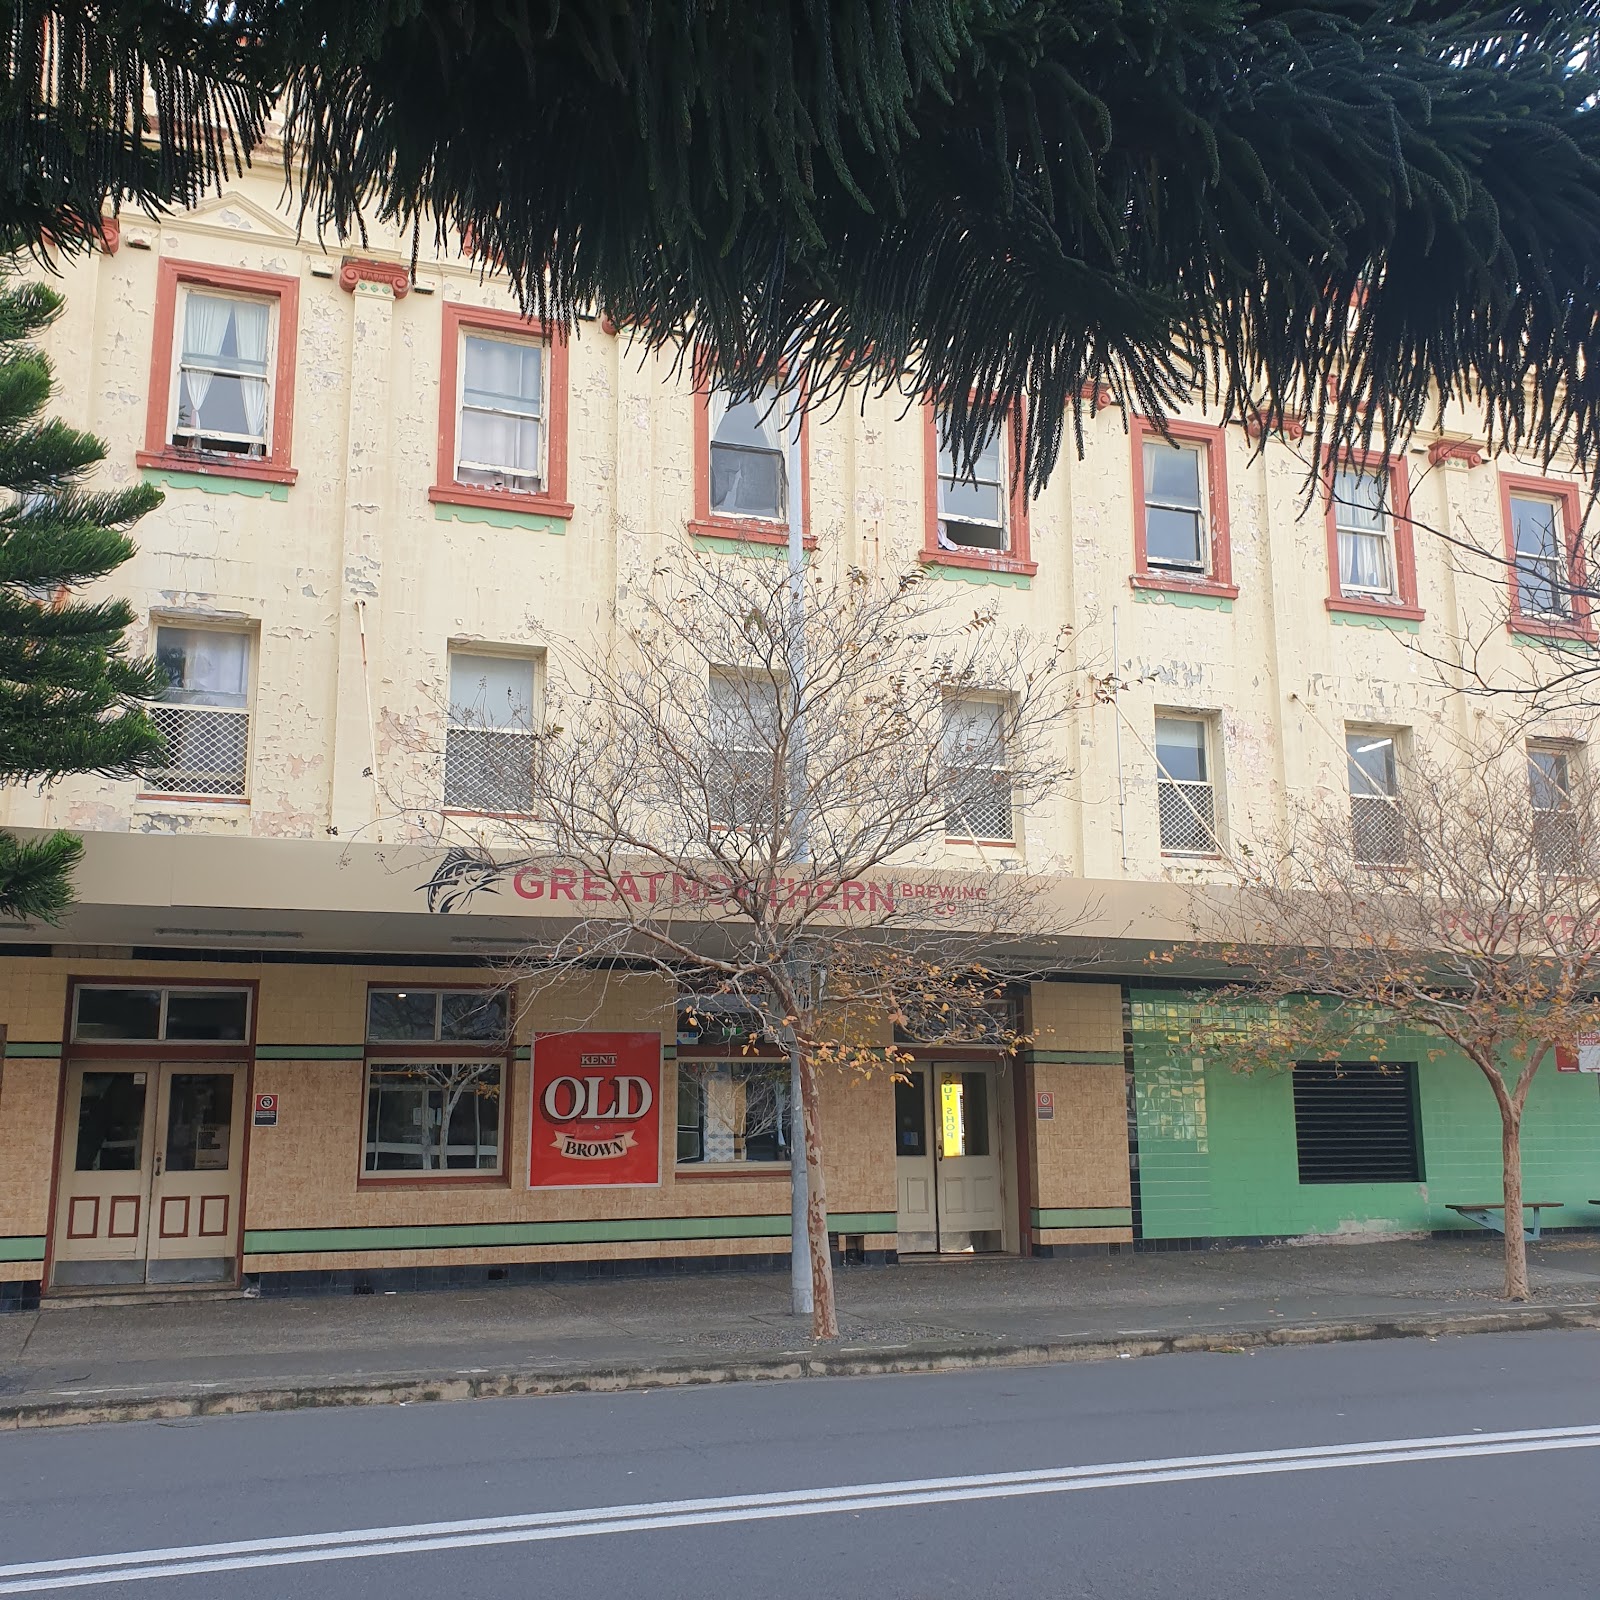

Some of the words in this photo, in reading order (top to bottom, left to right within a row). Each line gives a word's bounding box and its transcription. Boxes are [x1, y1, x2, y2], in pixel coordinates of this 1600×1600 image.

[513, 865, 666, 903] GREAT
[902, 883, 988, 900] BREWING
[581, 1054, 617, 1065] KENT
[542, 1076, 653, 1121] OLD
[565, 1140, 624, 1157] BROWN
